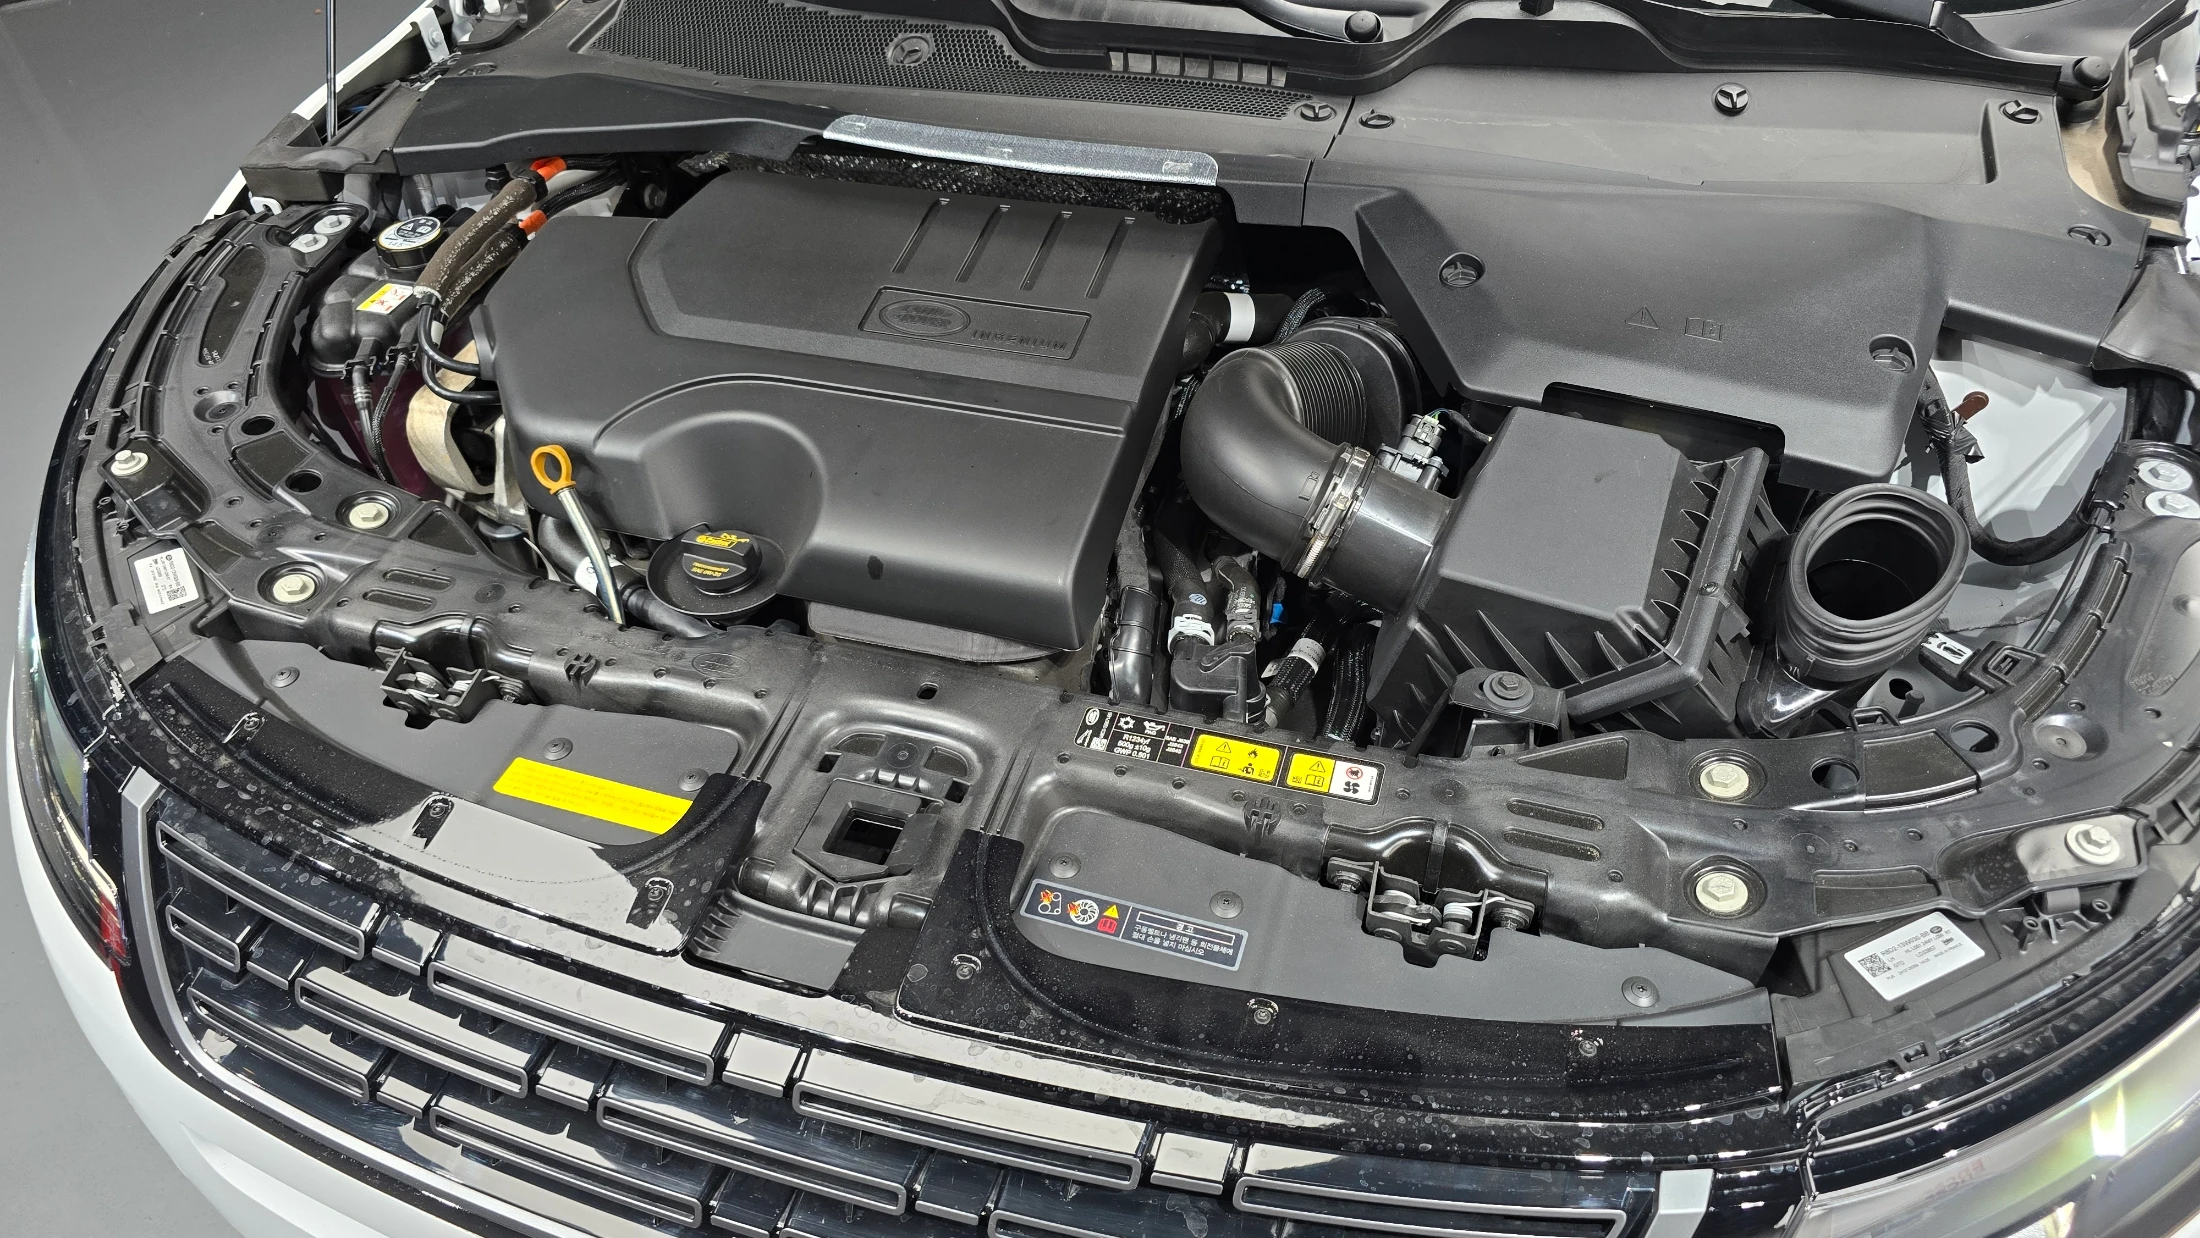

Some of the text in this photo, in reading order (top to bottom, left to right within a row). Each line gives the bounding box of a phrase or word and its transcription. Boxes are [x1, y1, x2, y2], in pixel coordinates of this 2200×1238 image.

[902, 304, 948, 316] LAND
[899, 313, 952, 329] ROVER
[971, 329, 1068, 351] INGENIUM
[1123, 734, 1151, 745] R1234yf
[1147, 935, 1160, 945] 손을
[1178, 943, 1205, 956] 마십시오
